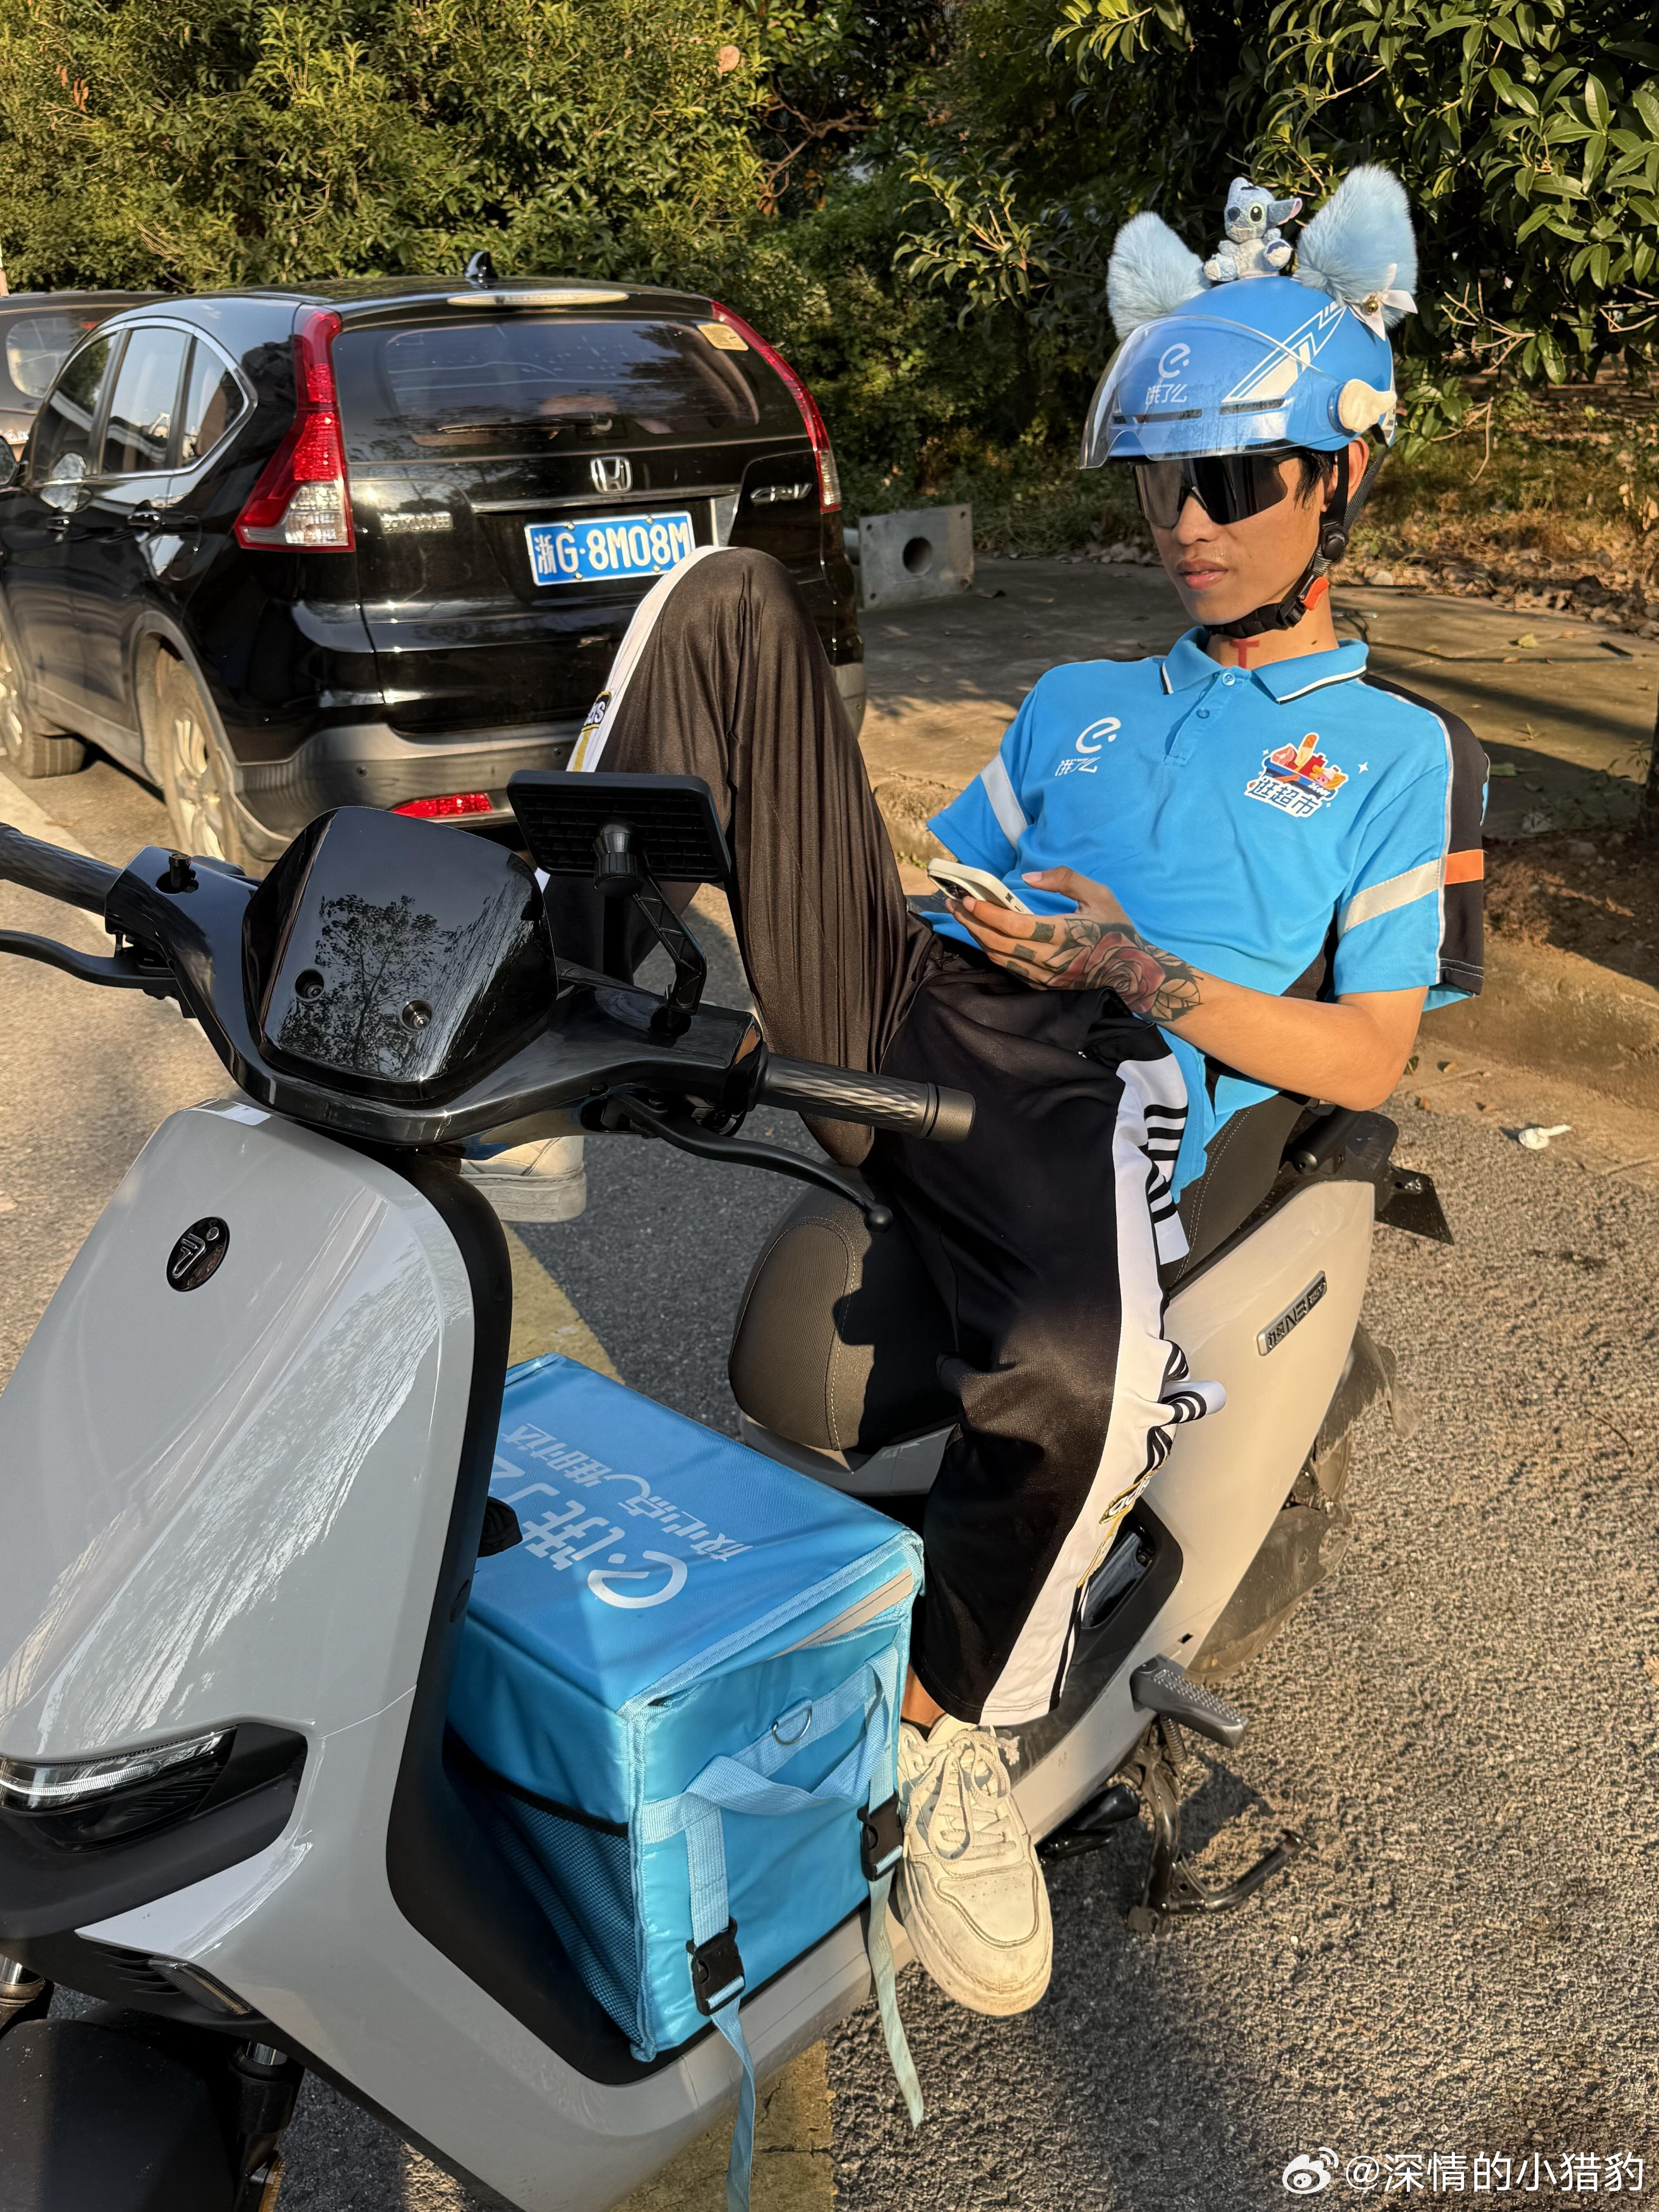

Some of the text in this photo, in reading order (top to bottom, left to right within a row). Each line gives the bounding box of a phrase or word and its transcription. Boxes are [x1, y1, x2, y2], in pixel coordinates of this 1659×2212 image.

[1145, 383, 1188, 405] 饿了么
[1055, 757, 1101, 777] 饿了么
[1249, 778, 1319, 814] 逛超市
